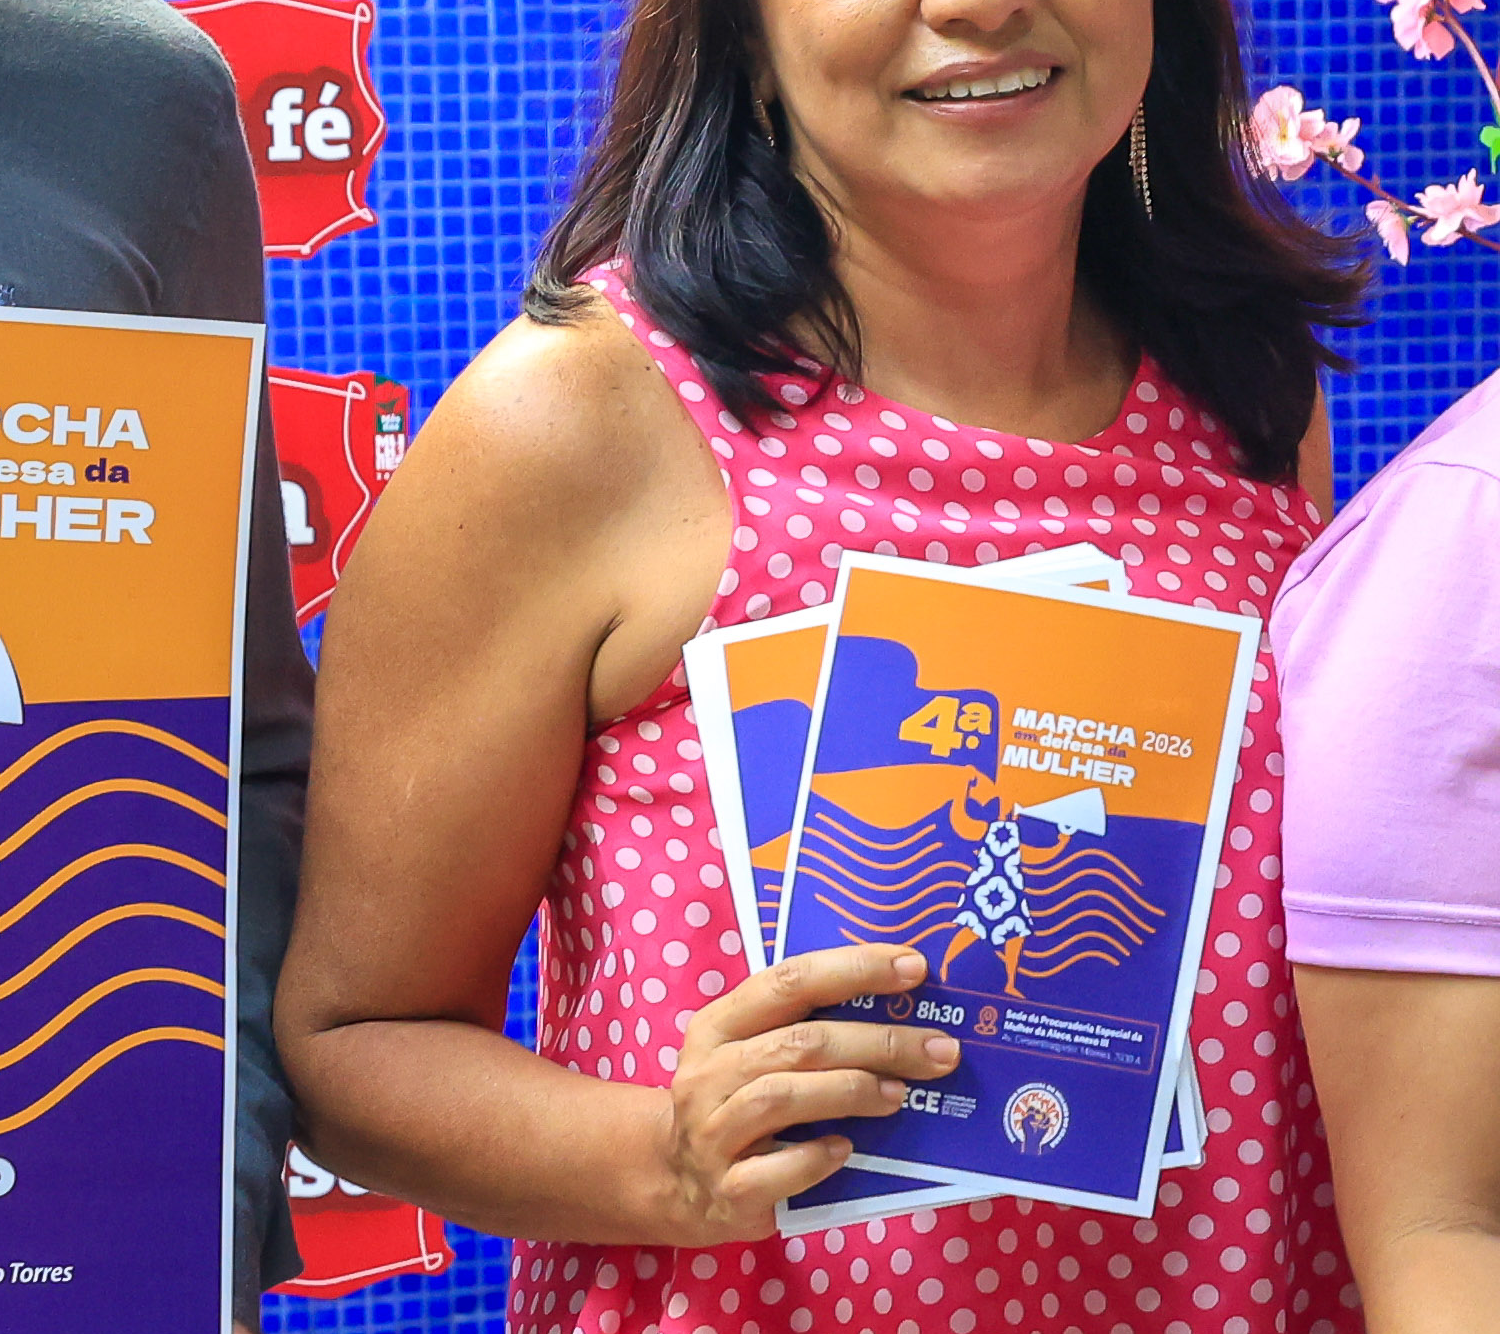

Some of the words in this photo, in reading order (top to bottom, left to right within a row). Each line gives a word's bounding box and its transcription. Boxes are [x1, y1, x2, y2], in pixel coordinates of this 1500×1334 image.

[83, 454, 131, 486] da
[1012, 707, 1137, 748] MARCHA
[1141, 730, 1193, 759] 2026
[1039, 731, 1105, 757] defesa
[1001, 744, 1137, 788] MULHER
[916, 1000, 965, 1026] 8h30
[901, 1086, 942, 1115] ECE
[8, 1261, 74, 1287] Torres
